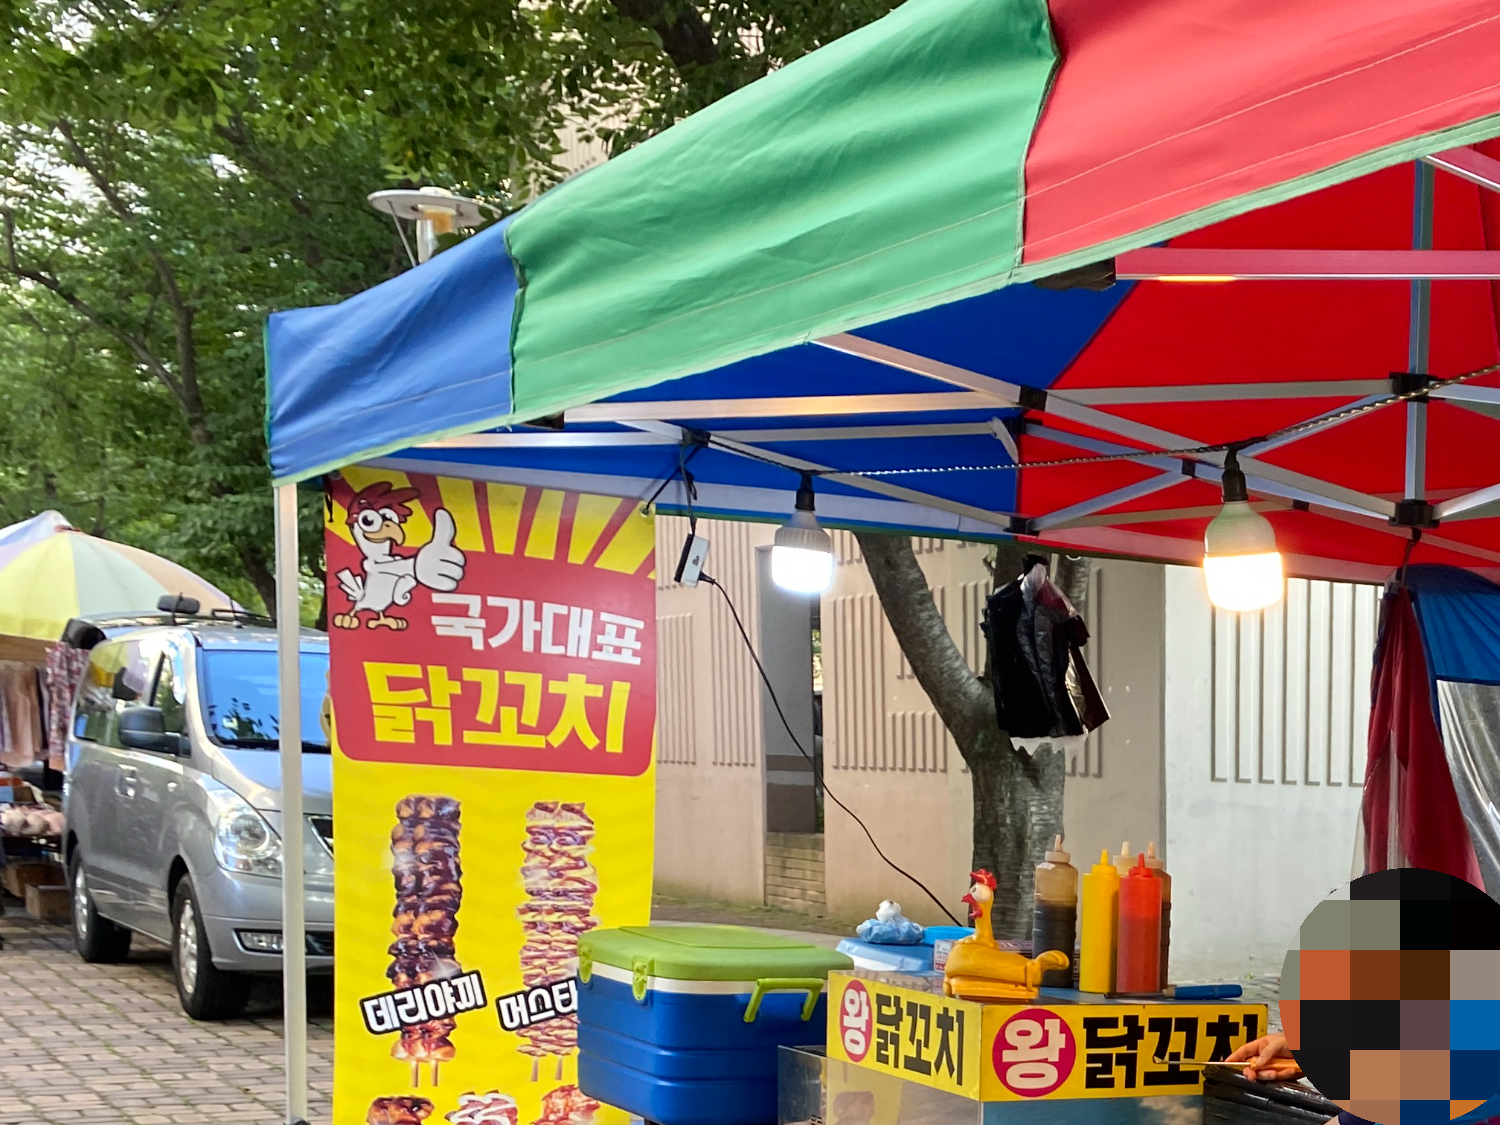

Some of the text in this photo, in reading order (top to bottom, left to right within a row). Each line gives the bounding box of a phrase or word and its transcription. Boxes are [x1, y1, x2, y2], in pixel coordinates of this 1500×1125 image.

[431, 593, 645, 665] 국가대표
[363, 661, 631, 753] 닭꼬치
[363, 972, 485, 1032] 데리야끼
[499, 979, 578, 1029] 머스타
[843, 988, 964, 1086] 왕 닭꼬치
[1001, 1014, 1258, 1090] 왕 닭꼬치
